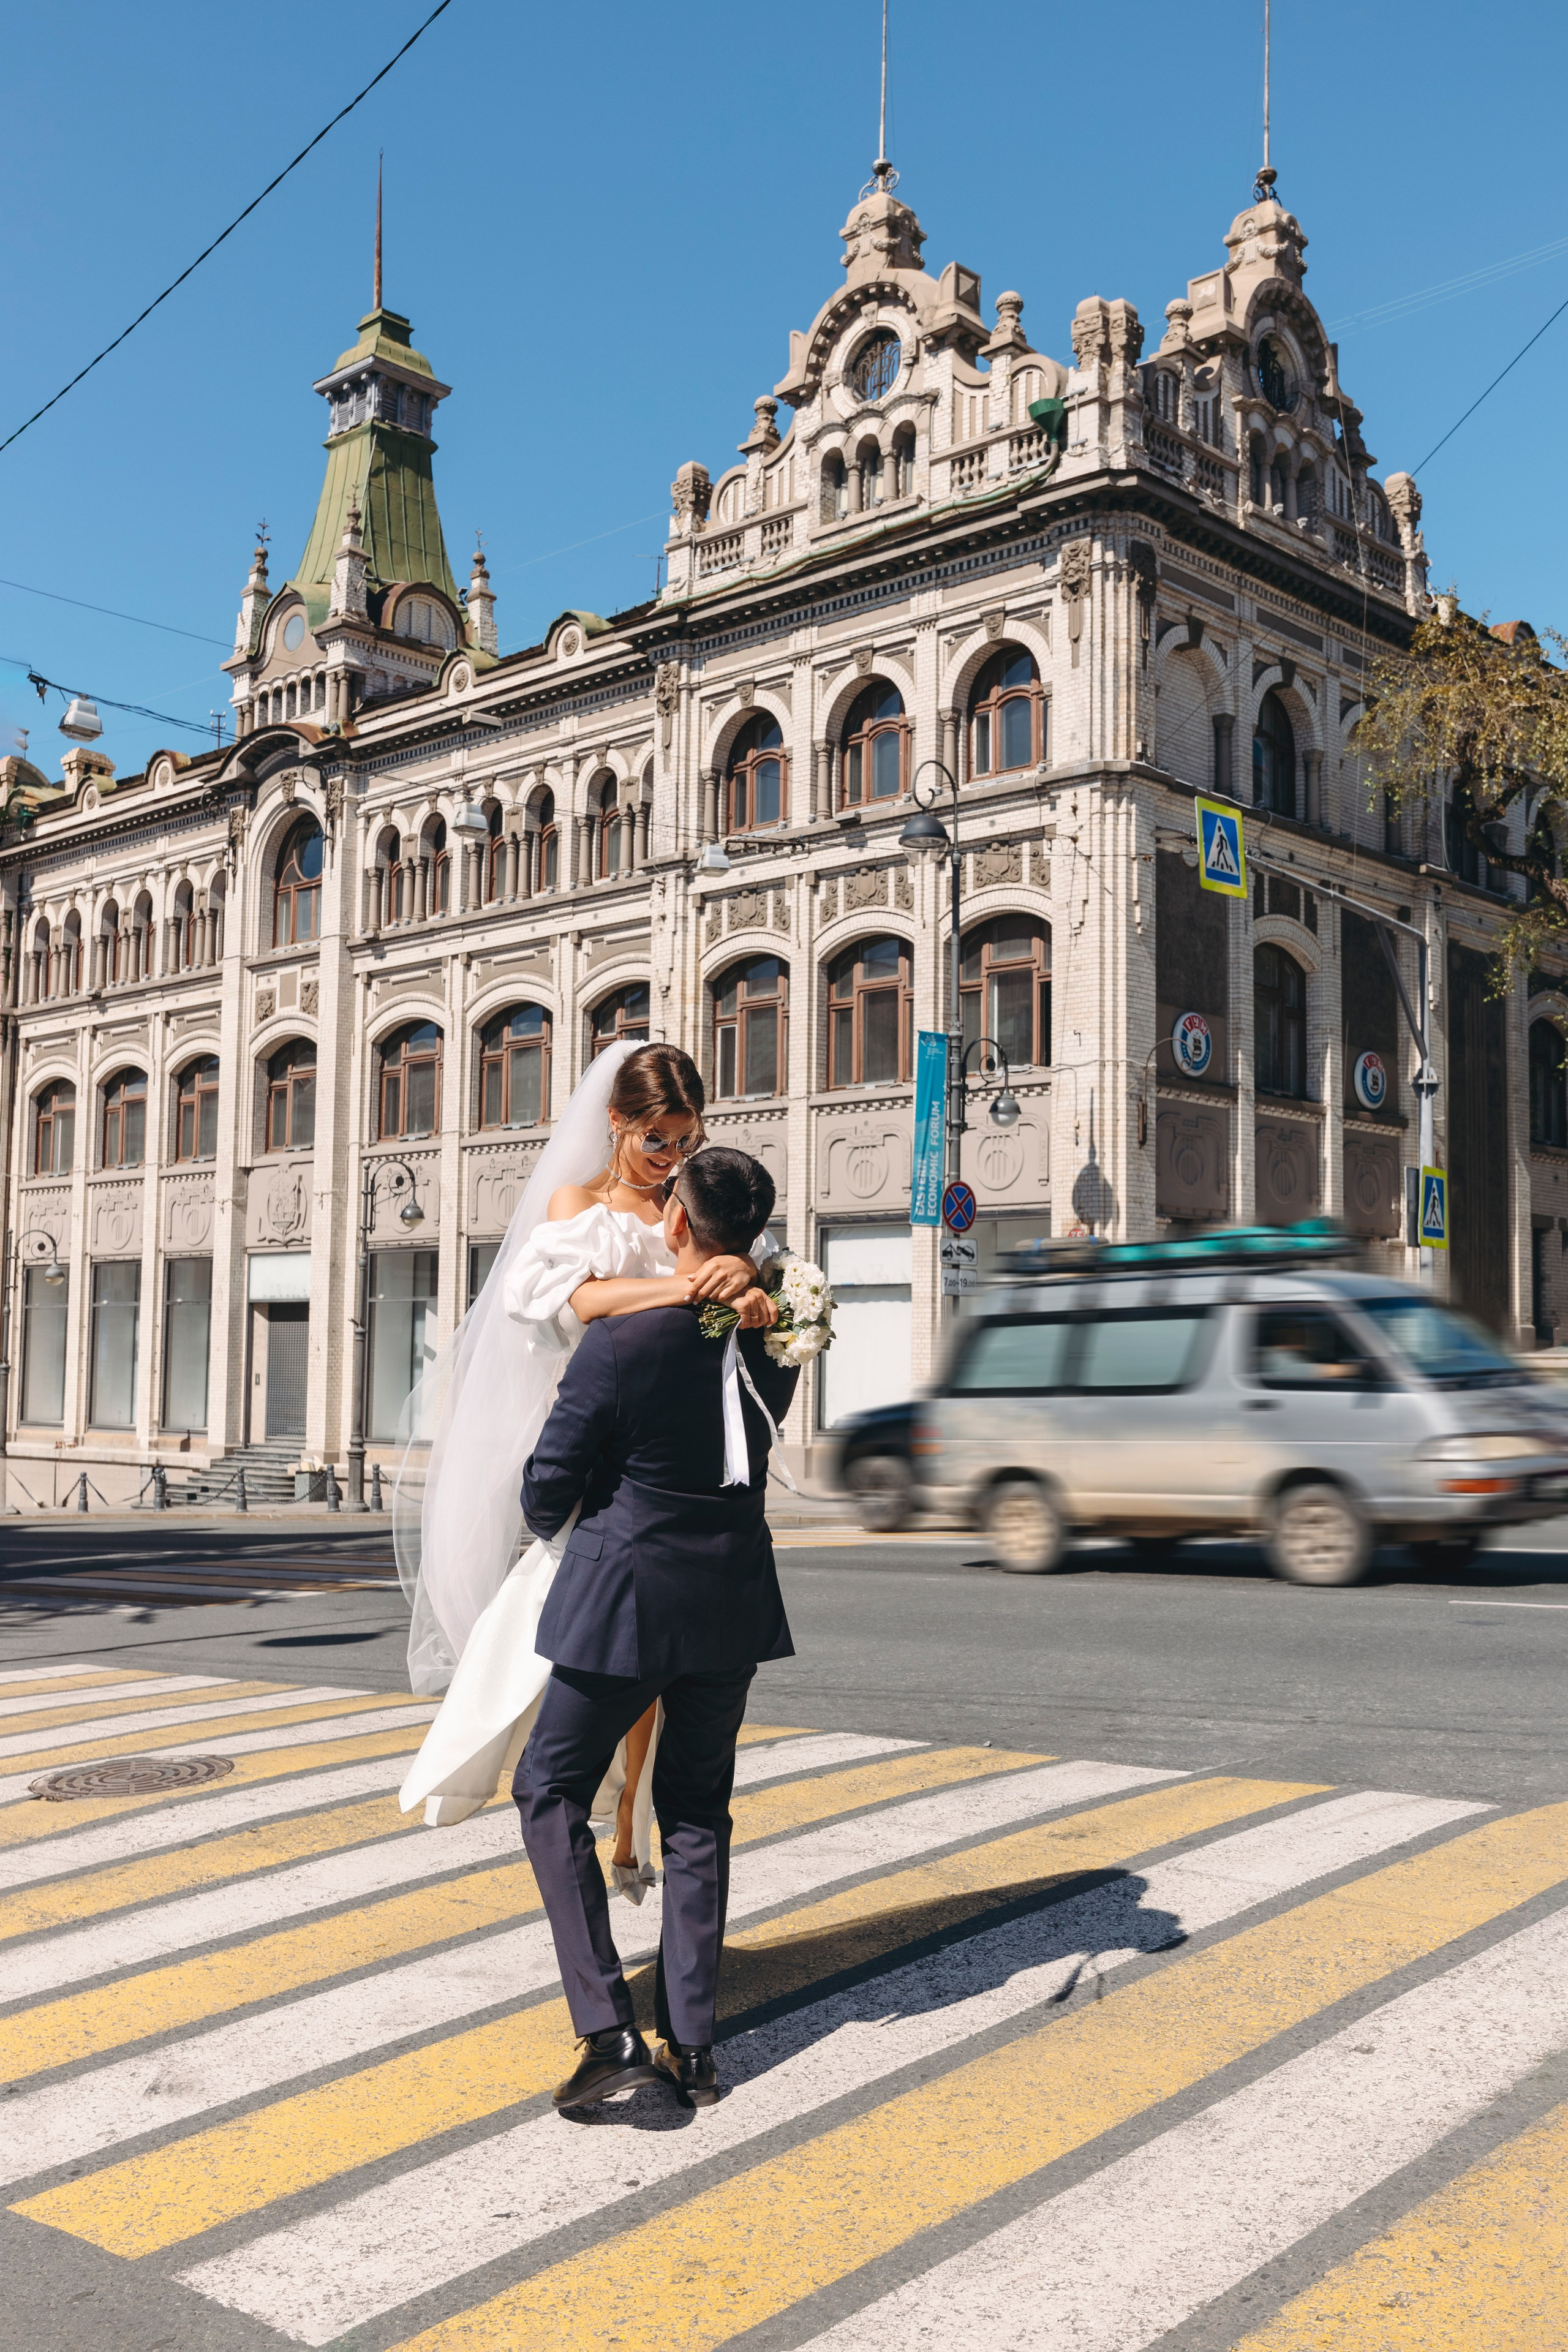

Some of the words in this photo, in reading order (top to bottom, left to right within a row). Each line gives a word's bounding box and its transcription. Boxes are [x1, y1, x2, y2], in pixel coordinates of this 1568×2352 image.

[1185, 1016, 1207, 1035] ГУМ
[1365, 1055, 1384, 1072] ГУМ
[930, 1101, 940, 1146] FORUM
[927, 1151, 938, 1216] ECONOMIC
